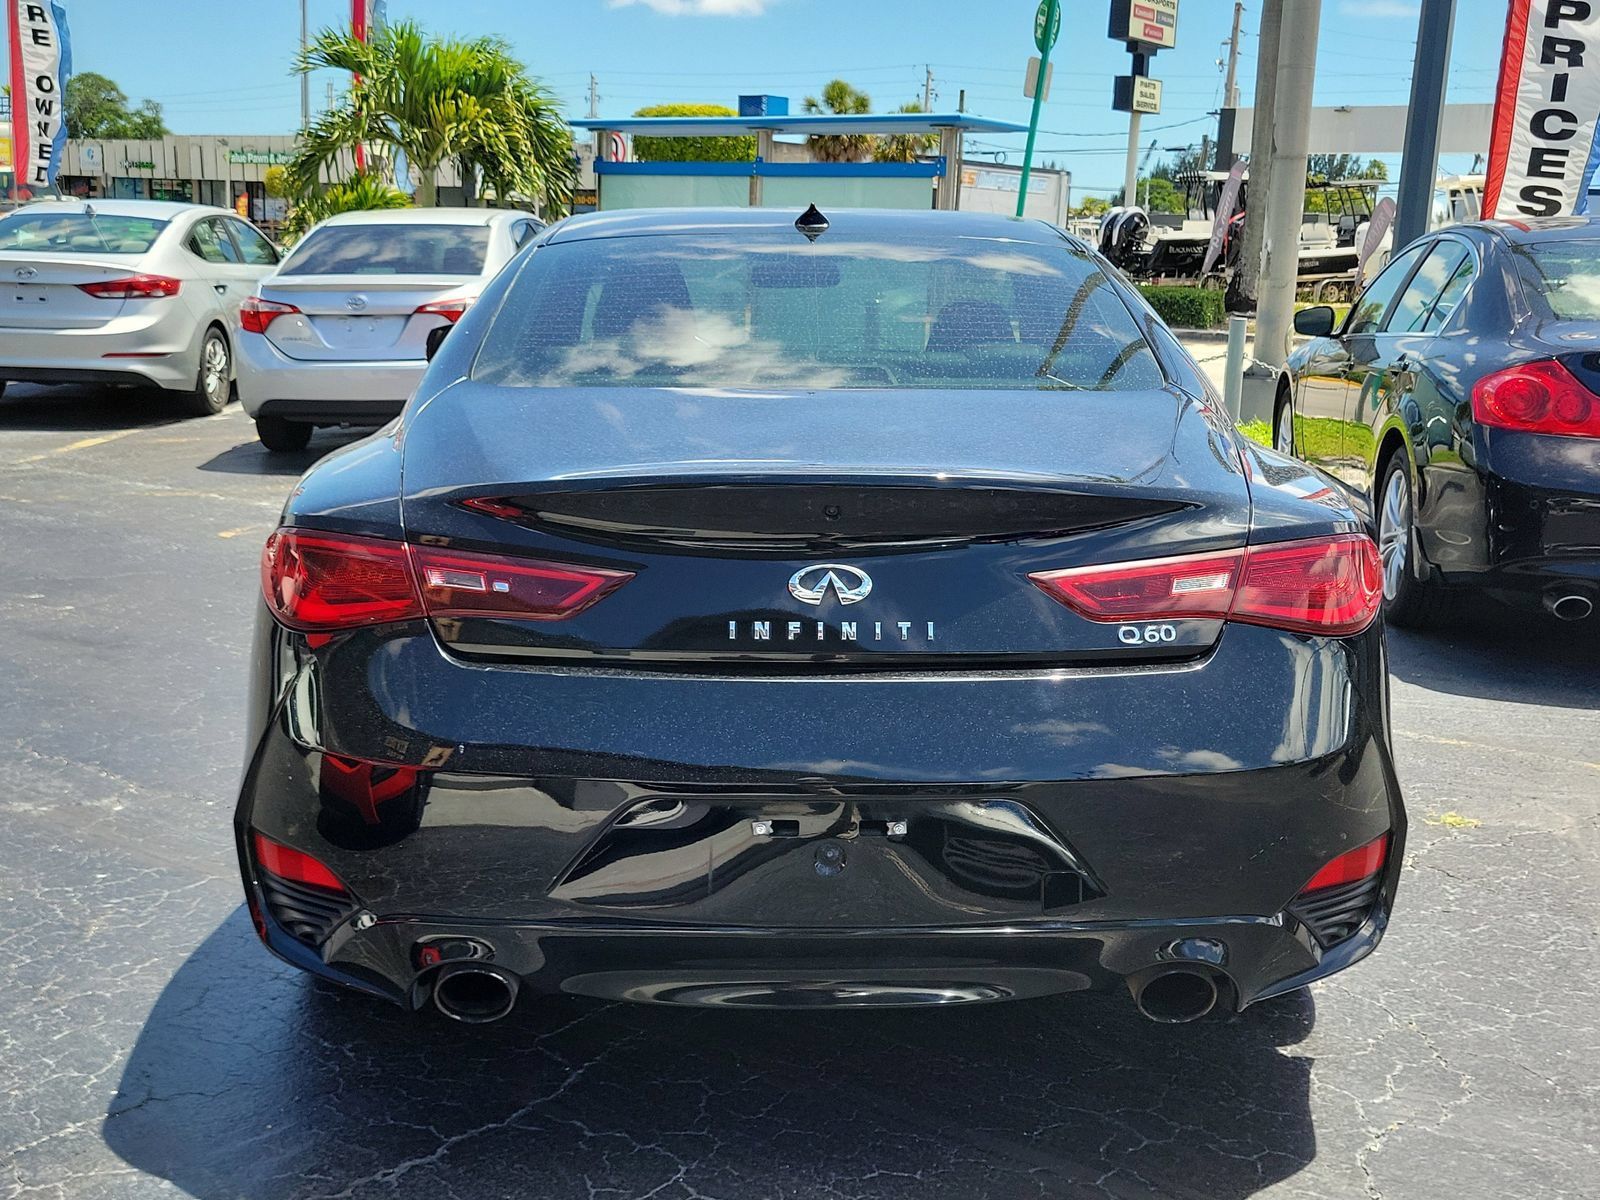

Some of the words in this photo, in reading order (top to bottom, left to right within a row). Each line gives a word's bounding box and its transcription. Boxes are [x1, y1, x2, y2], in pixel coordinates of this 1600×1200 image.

[1135, 100, 1158, 111] SERVICE
[1516, 0, 1591, 217] PRICES
[247, 153, 269, 164] Pawn
[728, 620, 934, 641] INFINITI
[1118, 624, 1177, 645] Q60
